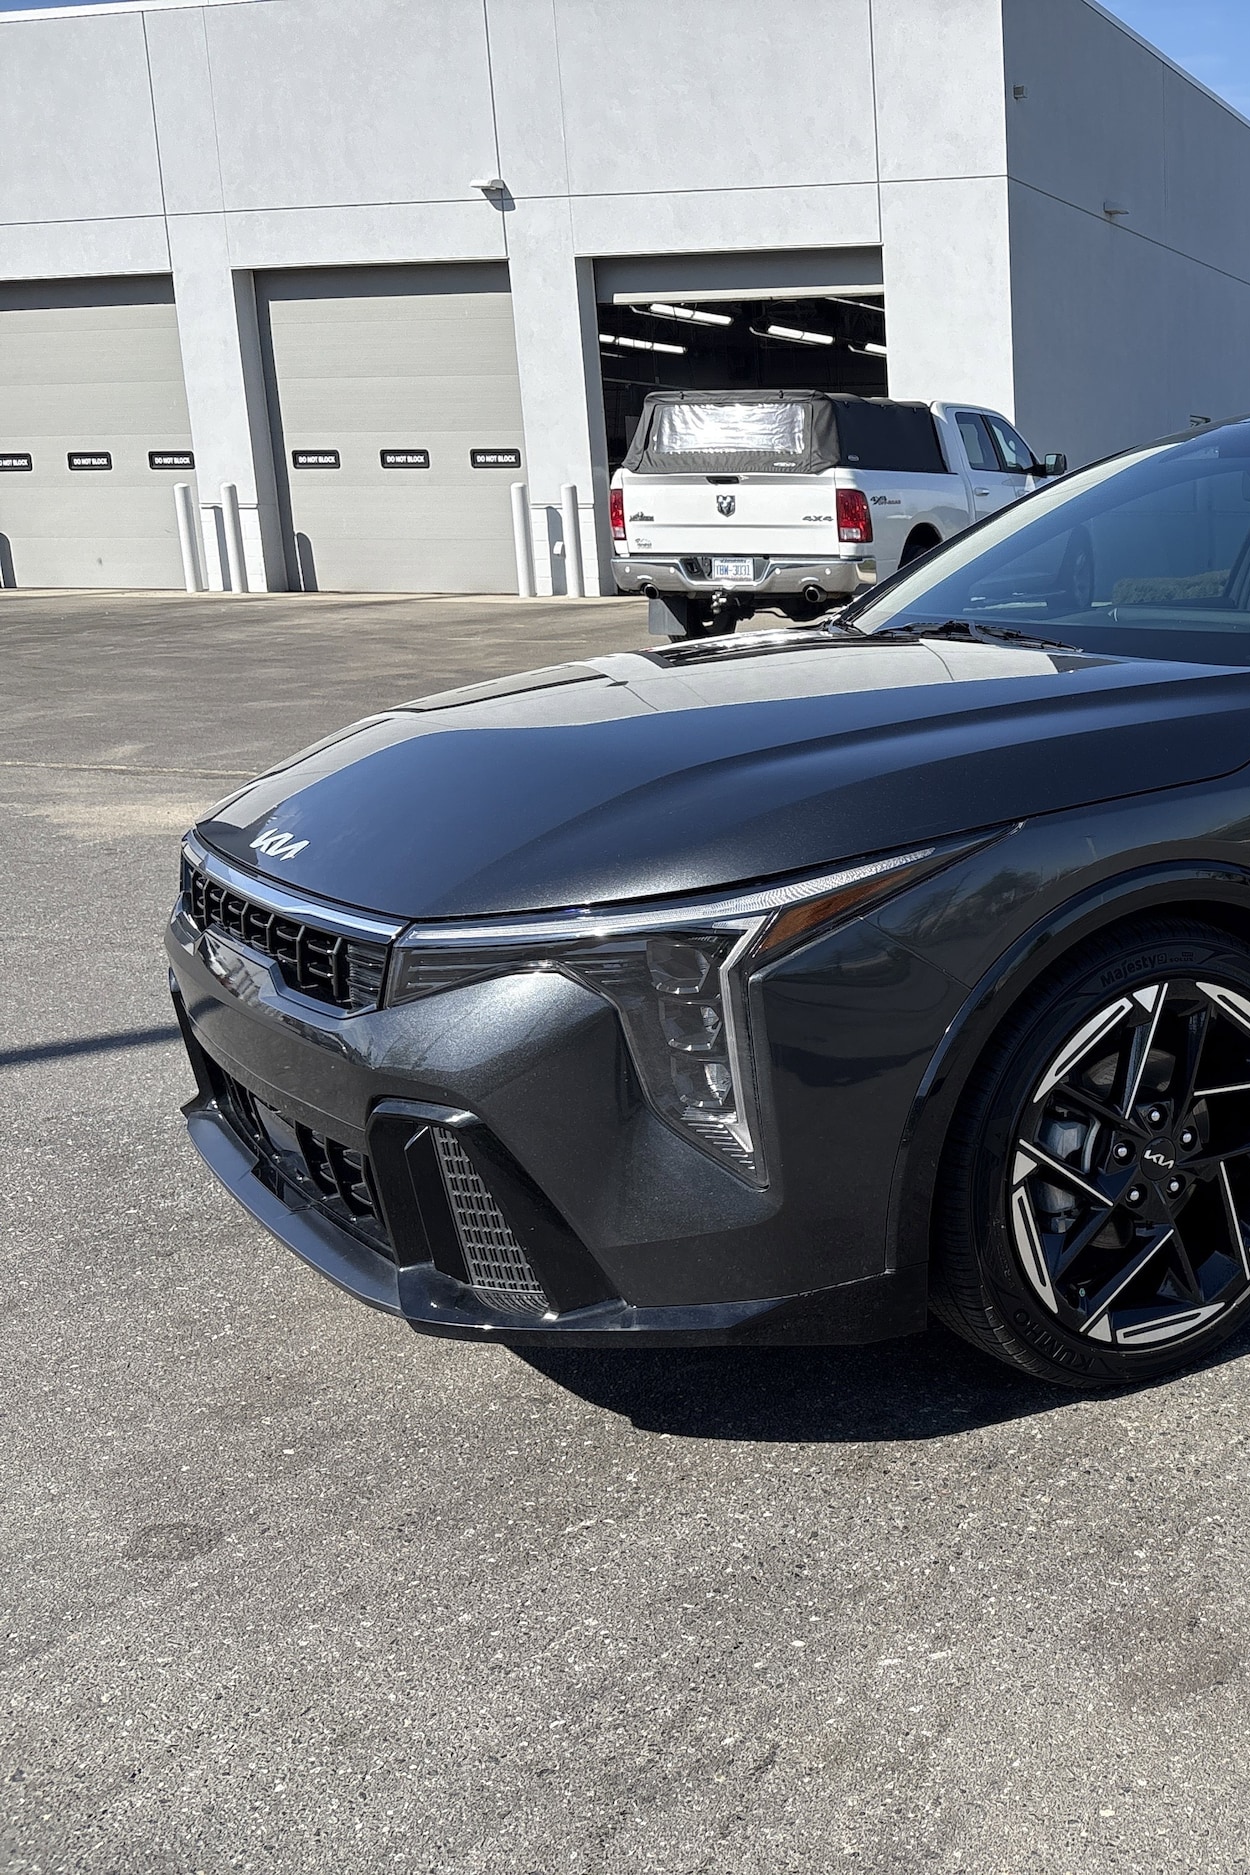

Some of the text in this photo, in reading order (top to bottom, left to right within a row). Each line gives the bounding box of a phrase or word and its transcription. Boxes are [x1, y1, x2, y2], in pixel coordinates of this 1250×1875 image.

[154, 456, 191, 464] DO NOT BLOCK
[386, 455, 424, 463] DO NOT BLOCK
[249, 828, 311, 861] KIA
[1144, 1149, 1175, 1169] KIA
[1013, 1308, 1095, 1372] KUMHO
